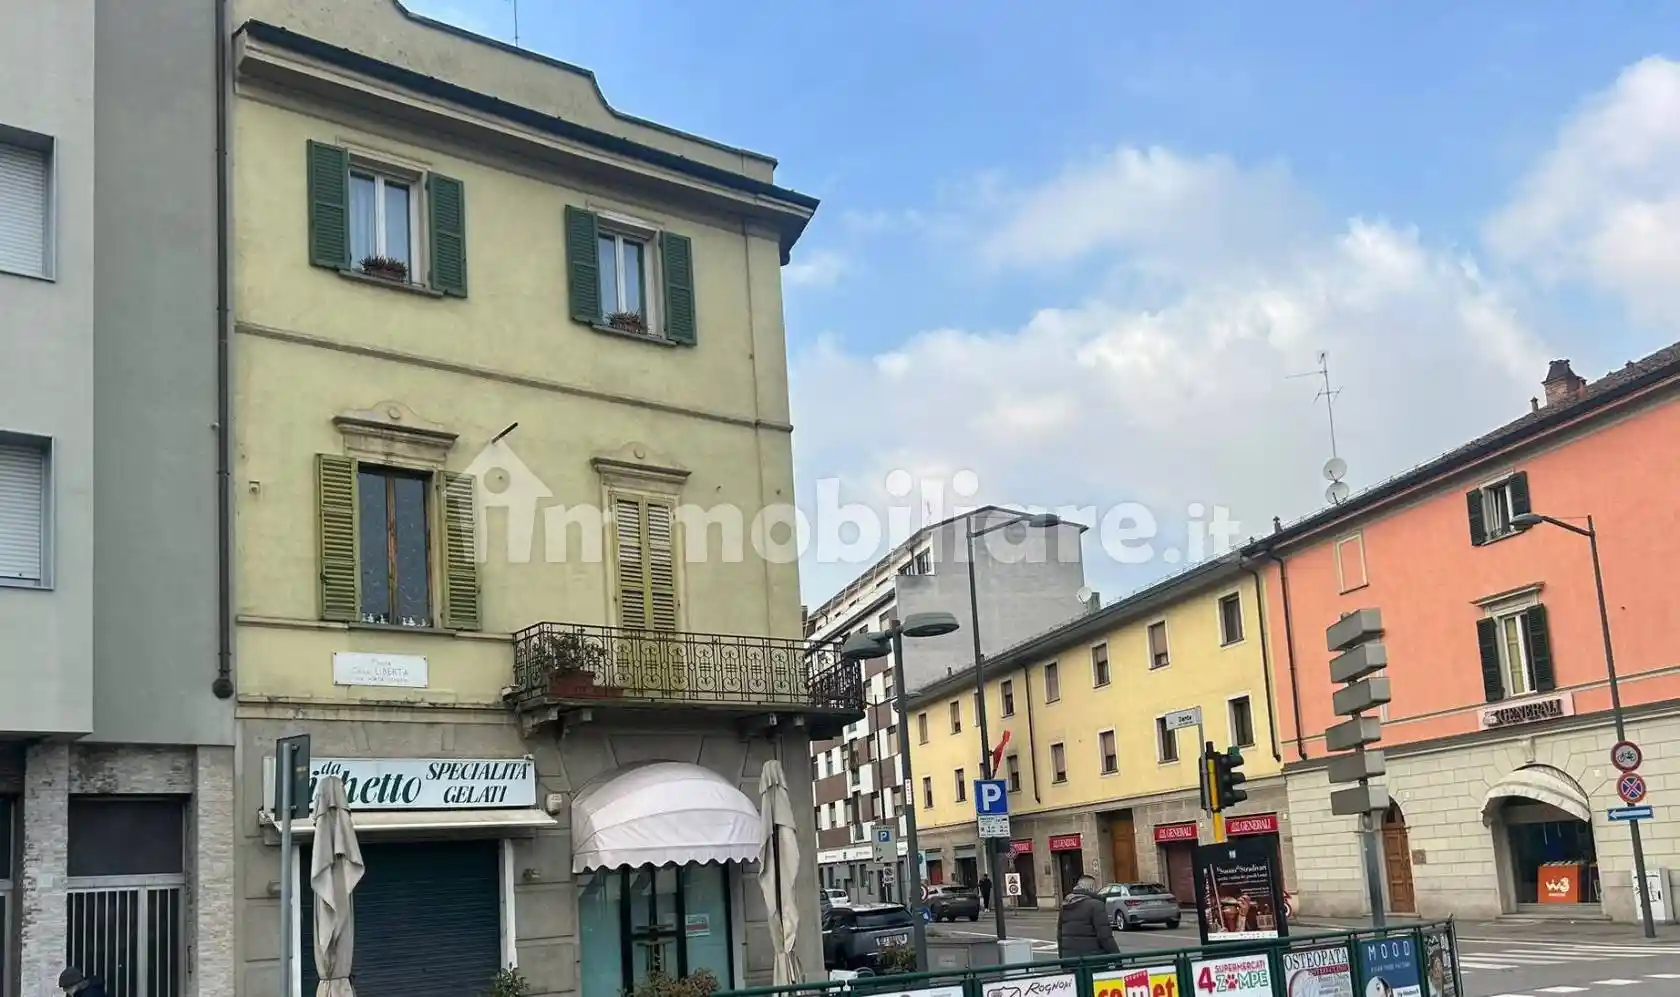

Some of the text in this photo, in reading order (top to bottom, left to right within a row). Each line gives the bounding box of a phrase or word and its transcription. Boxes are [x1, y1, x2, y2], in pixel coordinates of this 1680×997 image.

[321, 761, 341, 775] da
[443, 785, 507, 804] GELATI
[981, 783, 1002, 811] P
[1284, 948, 1349, 971] OSTEOPATA
[1368, 940, 1411, 961] MOOD
[1214, 960, 1266, 974] SUPERMERCATI
[1199, 967, 1216, 994] 4
